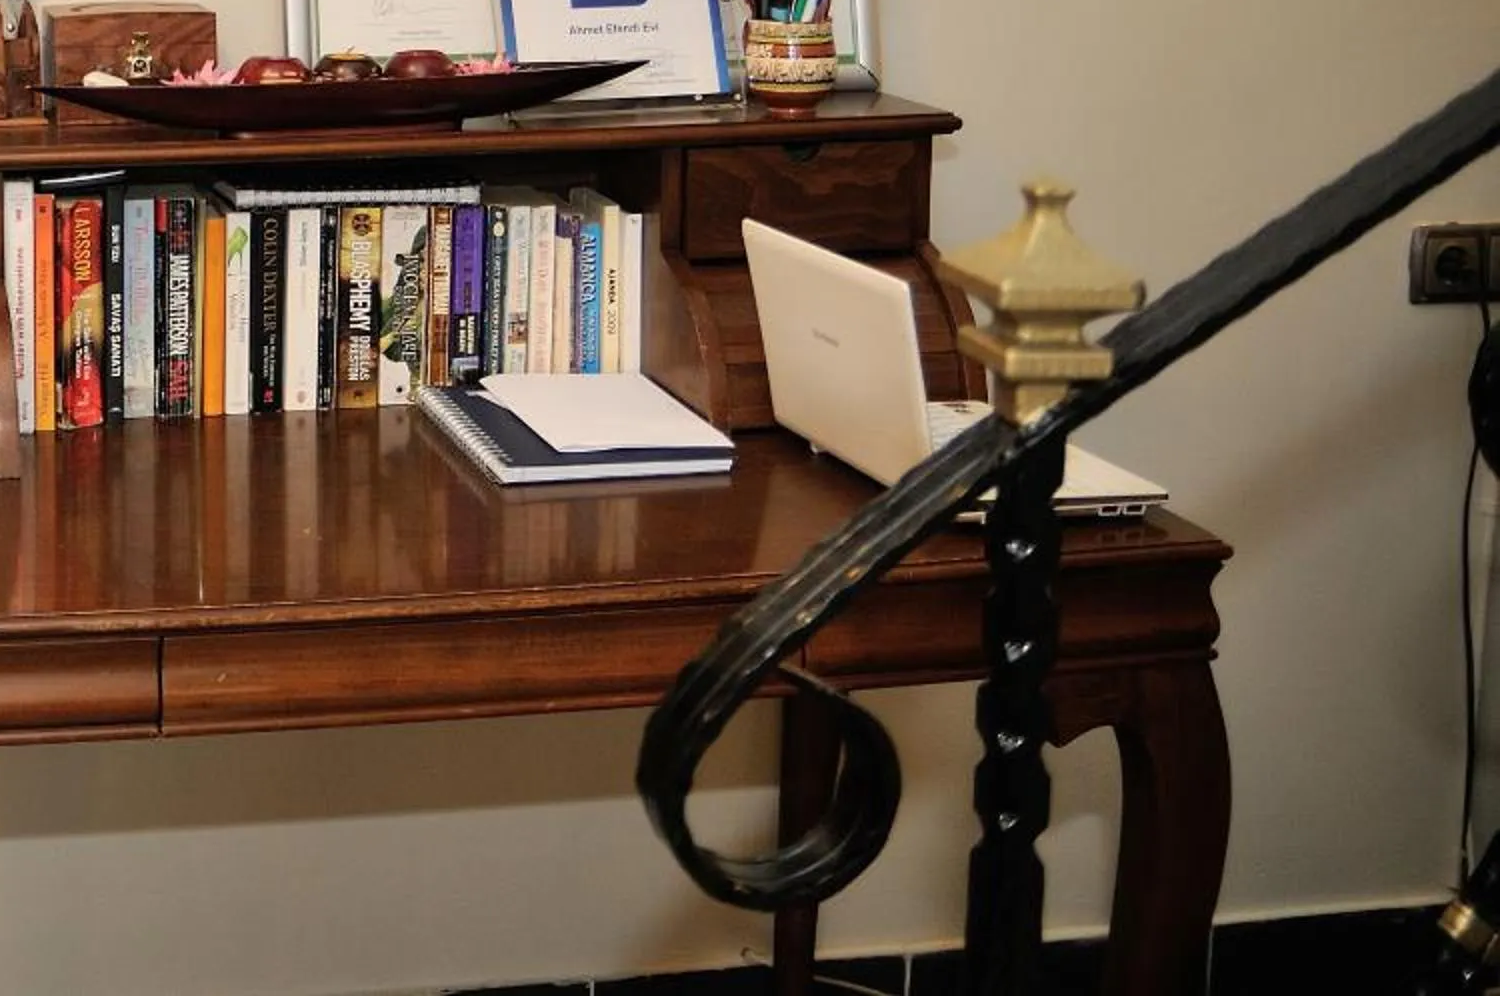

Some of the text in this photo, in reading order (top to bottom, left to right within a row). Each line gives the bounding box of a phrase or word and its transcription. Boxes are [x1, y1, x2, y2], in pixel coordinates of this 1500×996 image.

[73, 207, 92, 281] LARSSON
[262, 217, 278, 333] COLIN DEXTER
[581, 233, 598, 304] ALMANCA
[108, 293, 121, 333] SAVAŞ
[169, 253, 190, 356] JAMES PATTERSON
[349, 240, 372, 332] BLASPHEMY
[347, 335, 359, 381] PRESTON
[360, 335, 371, 381] DOUGLAS
